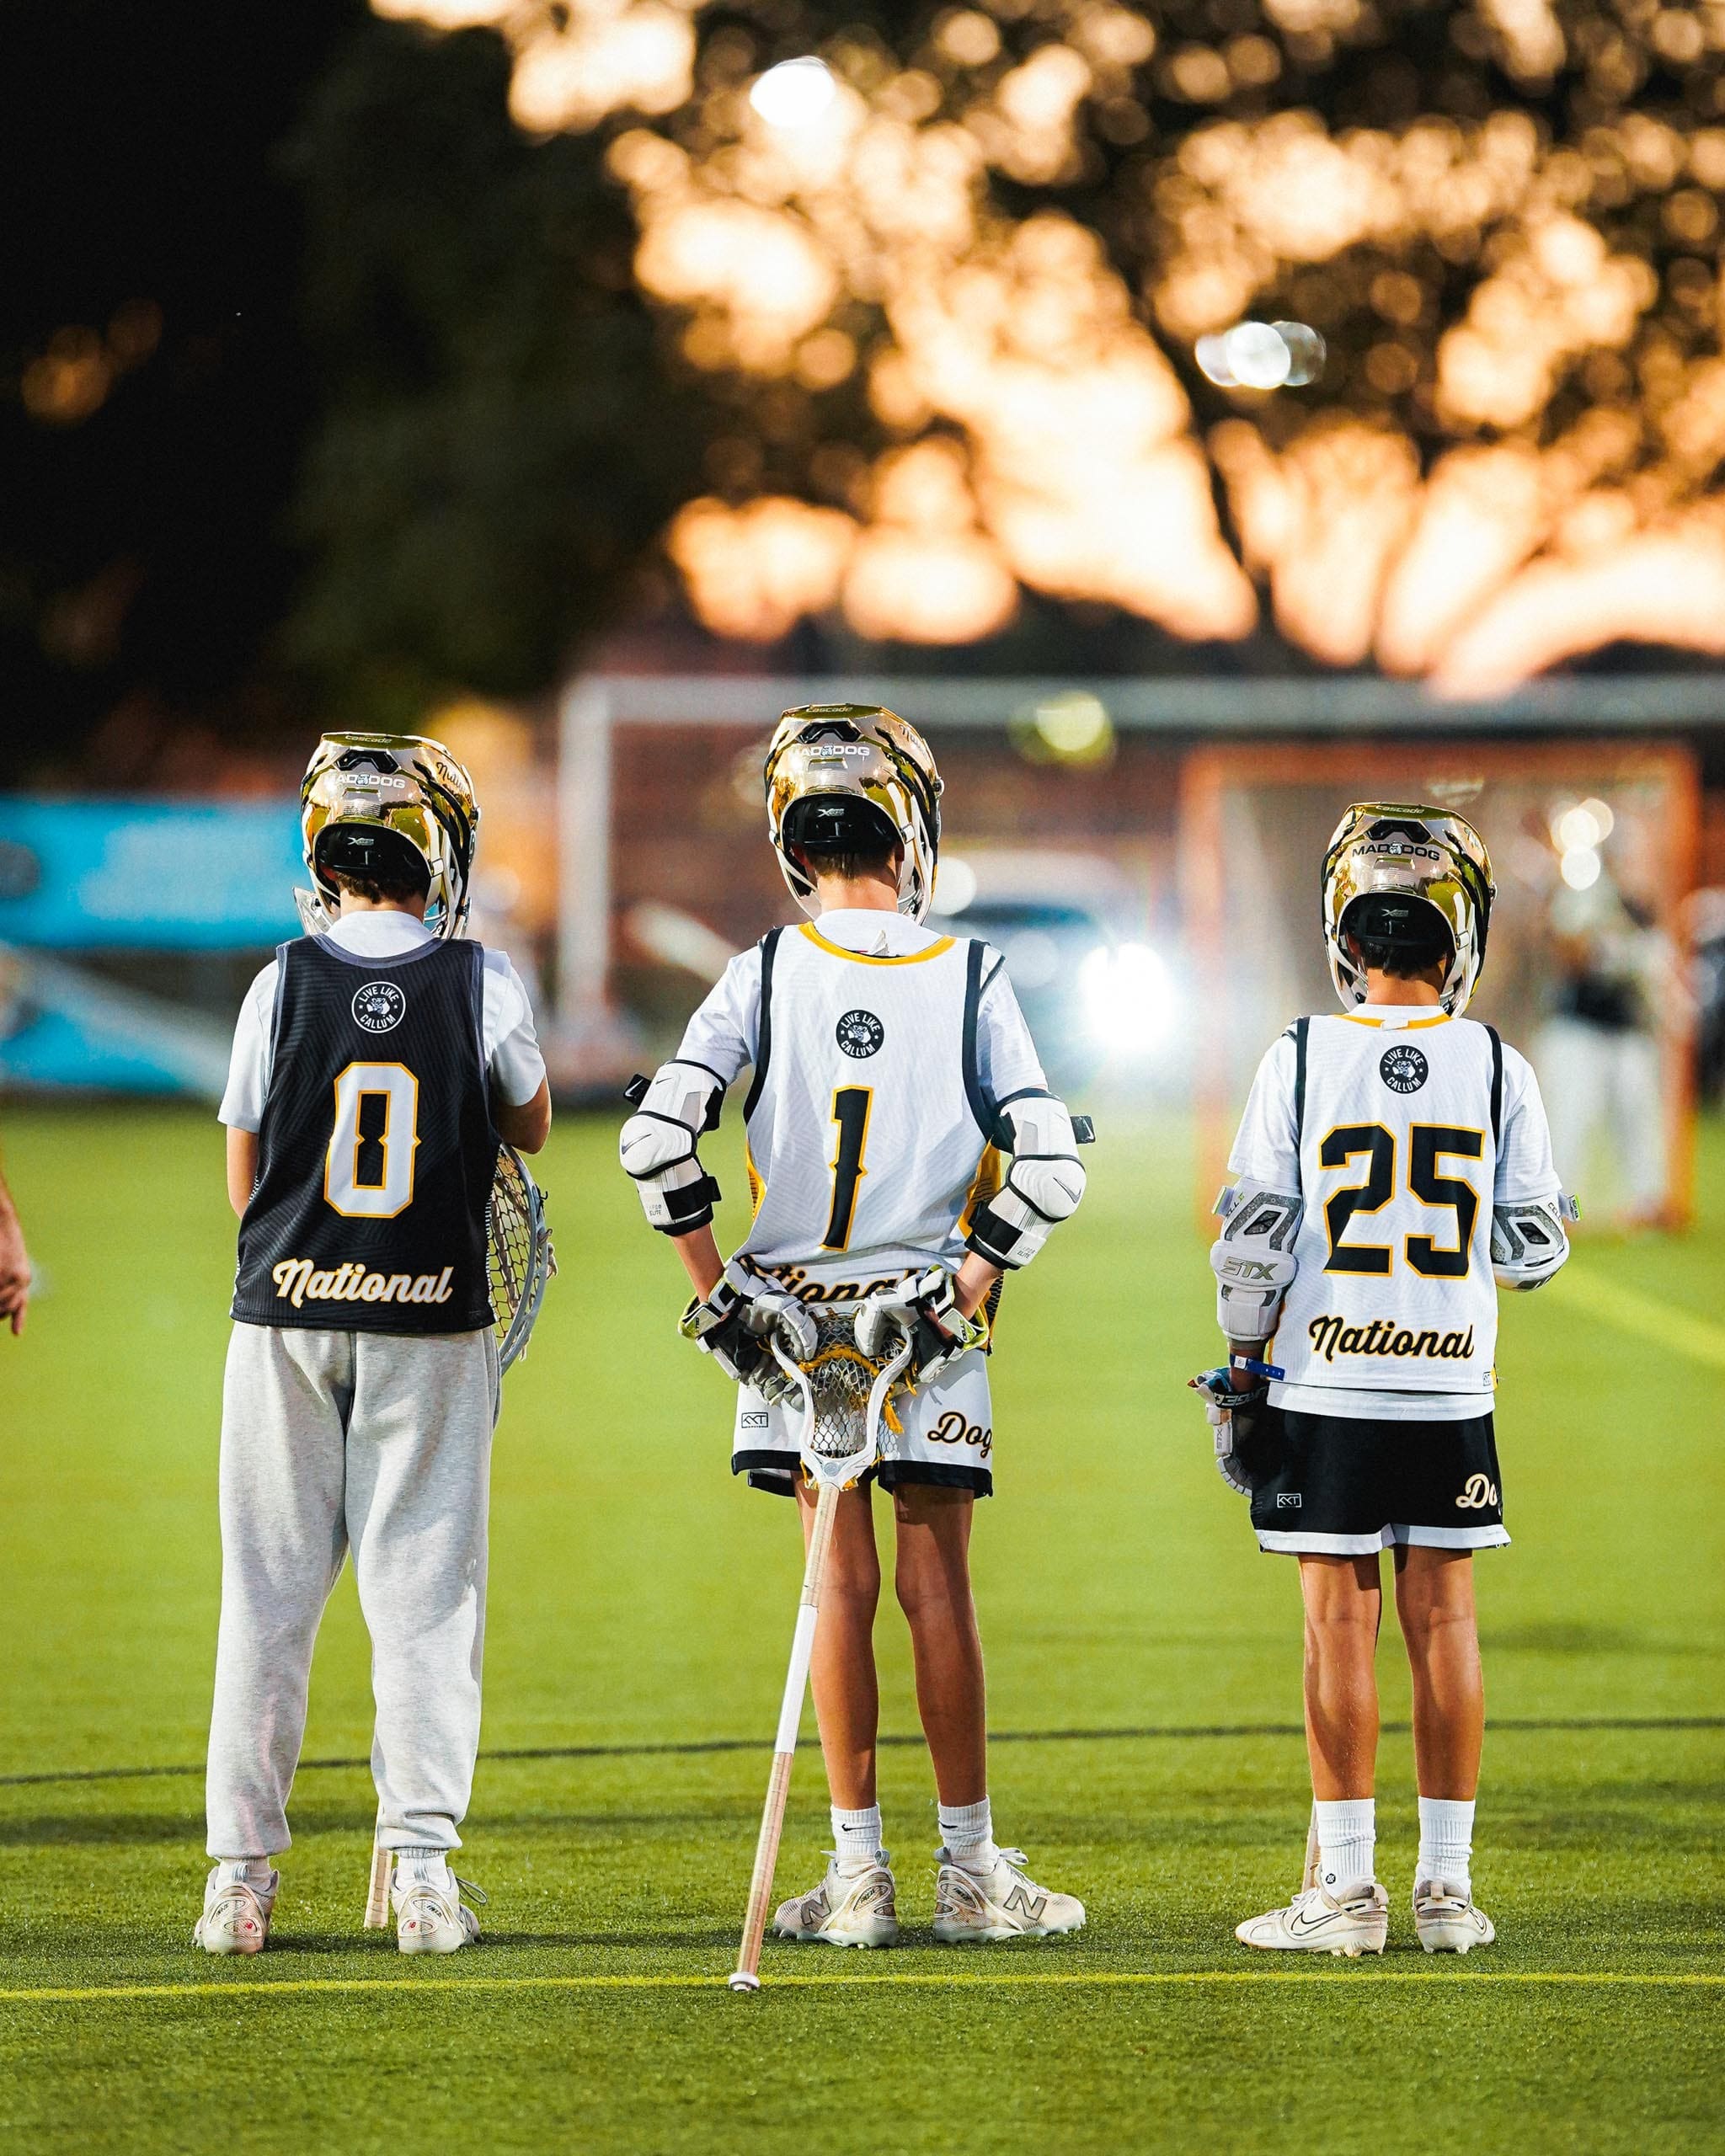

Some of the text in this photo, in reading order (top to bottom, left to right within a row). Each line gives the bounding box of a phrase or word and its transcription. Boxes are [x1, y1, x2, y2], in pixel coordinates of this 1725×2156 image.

[833, 745, 870, 756] DOG
[369, 774, 406, 788] DOG
[1352, 843, 1440, 862] MAD DOG
[358, 986, 399, 1002] LIVE LIKE
[360, 1014, 396, 1028] CALLUM
[841, 1012, 880, 1032] LIVE LIKE
[841, 1040, 875, 1056] CALLUM
[1384, 1049, 1423, 1065] LIVE LIKE
[1386, 1076, 1422, 1091] CALLUM
[323, 1061, 421, 1219] 0
[819, 1084, 873, 1252] 1
[1318, 1121, 1486, 1280] 25
[1220, 1256, 1279, 1281] STX
[272, 1258, 454, 1309] National
[1308, 1315, 1474, 1364] National
